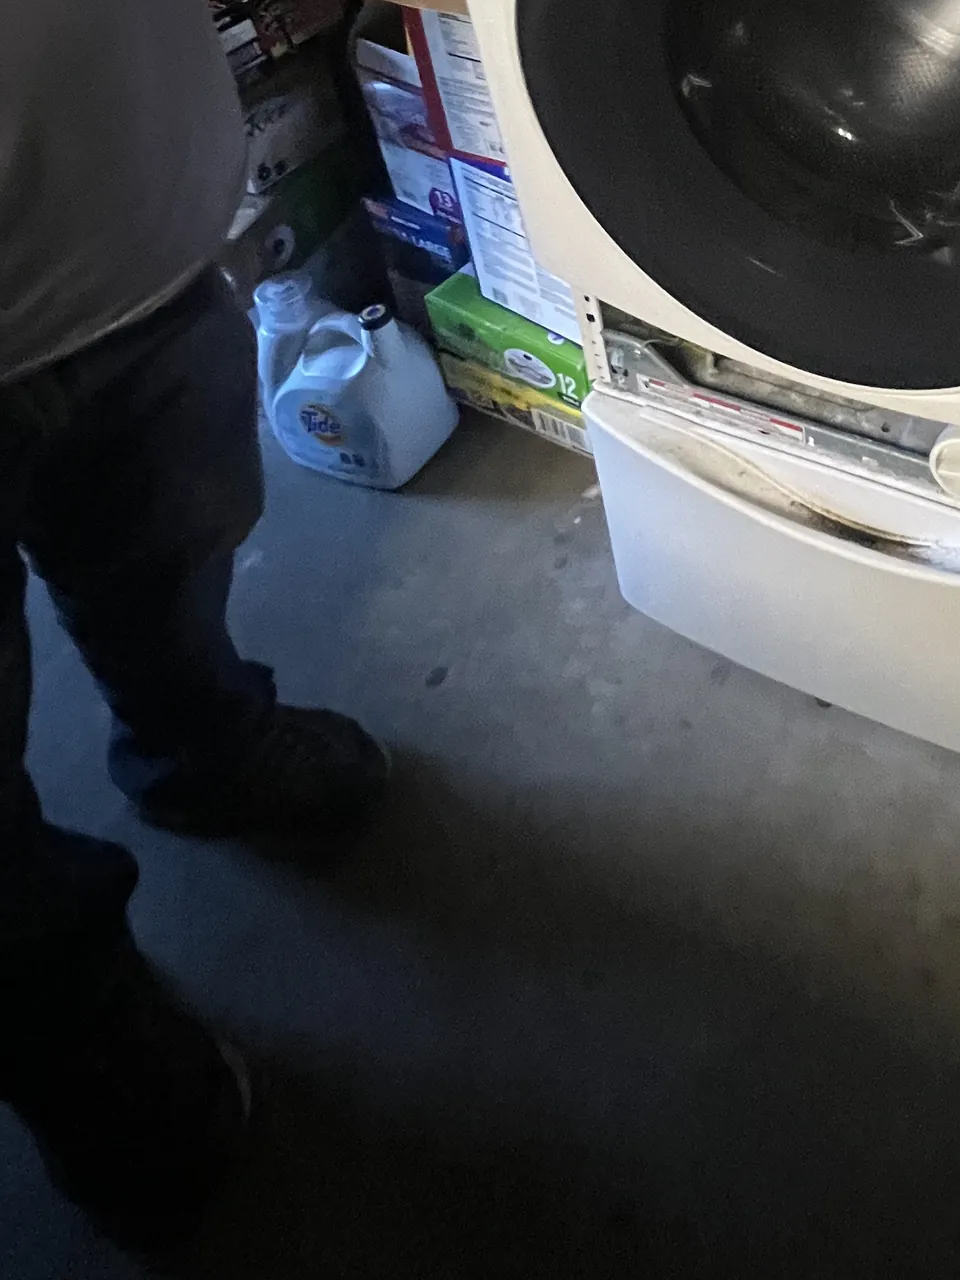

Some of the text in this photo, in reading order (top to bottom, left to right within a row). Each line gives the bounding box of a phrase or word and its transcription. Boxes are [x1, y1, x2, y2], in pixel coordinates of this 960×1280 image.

[435, 188, 456, 210] 13
[556, 373, 579, 399] 12
[300, 410, 341, 434] Tide
